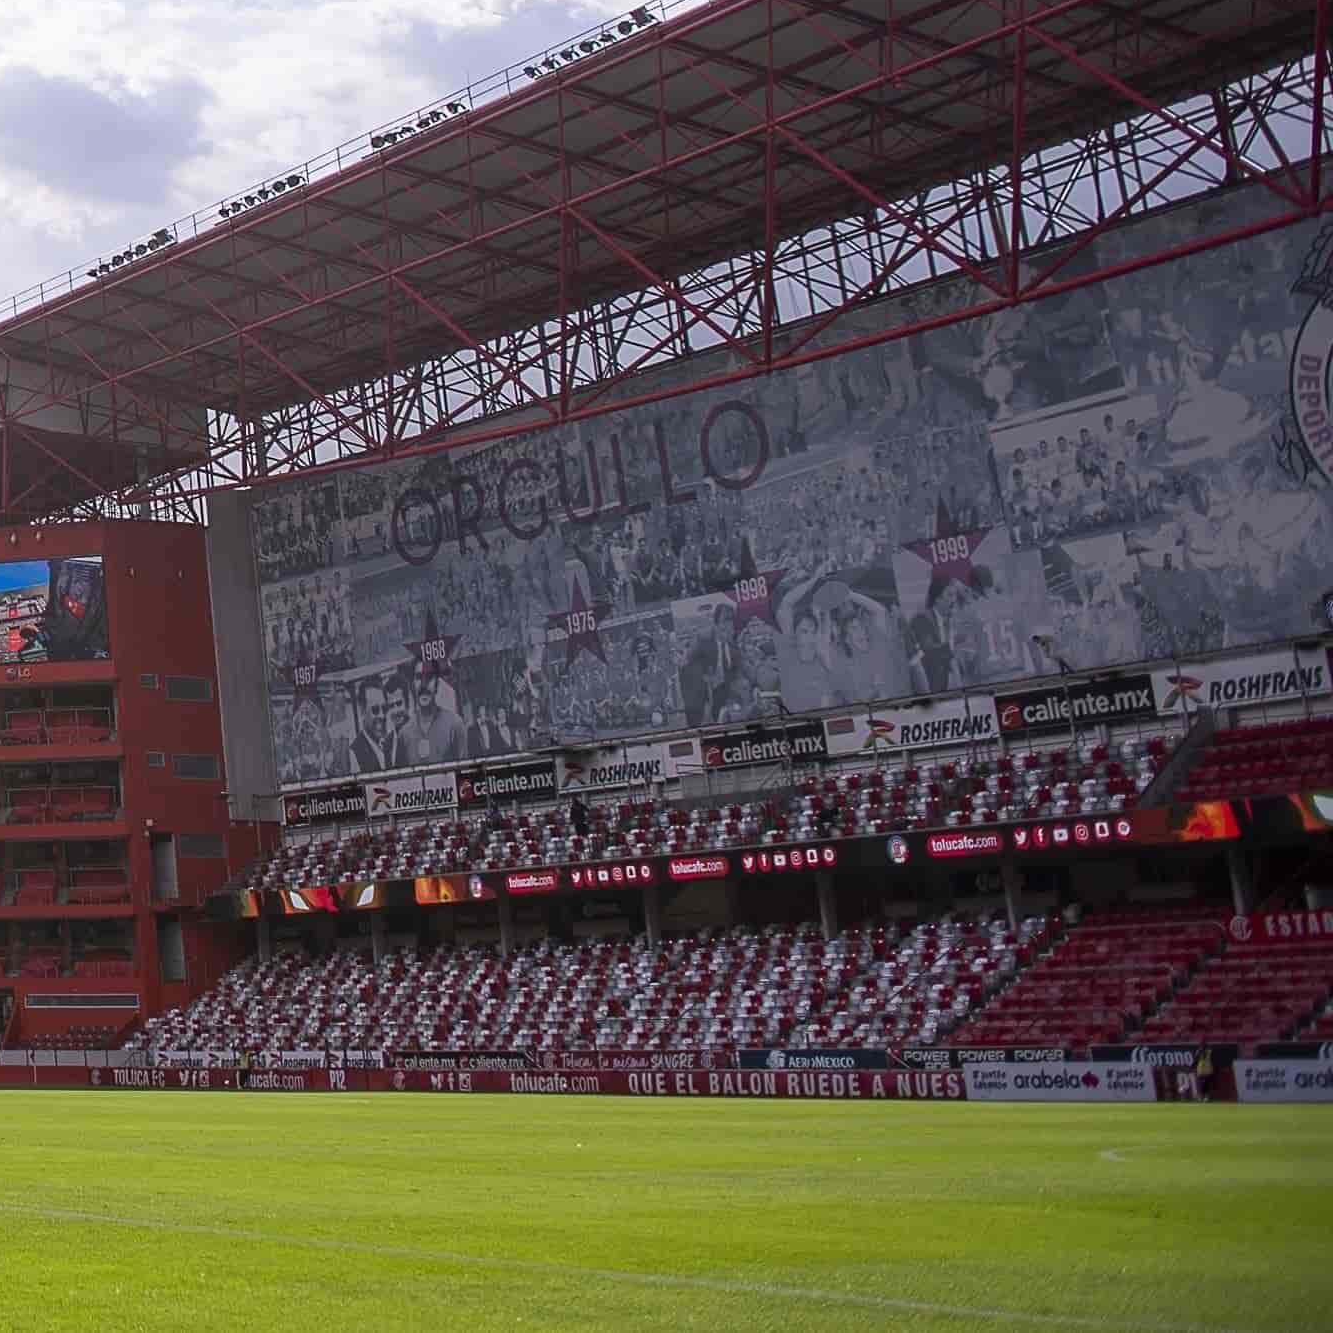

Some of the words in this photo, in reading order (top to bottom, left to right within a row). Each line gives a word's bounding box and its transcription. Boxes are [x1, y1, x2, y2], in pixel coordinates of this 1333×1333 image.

[391, 399, 770, 565] ORGULLO
[931, 535, 969, 565] 1999
[734, 577, 769, 603] 1998
[565, 609, 597, 635] 1975
[420, 639, 446, 662] 1968
[293, 664, 316, 685] 1967
[1209, 665, 1323, 704] ROSHFRANS
[1023, 687, 1152, 724] caliente.mx
[900, 713, 992, 744] ROSHFRANS
[722, 735, 824, 765] caliente.mx
[473, 770, 555, 797] caliente.mx
[931, 835, 998, 853] tolucafc.com
[670, 860, 725, 876] tolucafc.com
[508, 873, 555, 888] tolucafc.com
[650, 1052, 694, 1068] SANGRE
[903, 1050, 950, 1062] POWER
[957, 1050, 1005, 1062] POWER
[1014, 1049, 1065, 1061] POWER
[113, 1069, 149, 1087] TOLUCA
[151, 1069, 165, 1088] FC
[629, 1073, 666, 1094] QUE
[676, 1073, 699, 1094] EL
[708, 1073, 777, 1096] BALON
[787, 1073, 861, 1096] RUEDE
[873, 1074, 886, 1097] A
[897, 1073, 965, 1098] NUES
[1014, 1068, 1080, 1090] arabela
